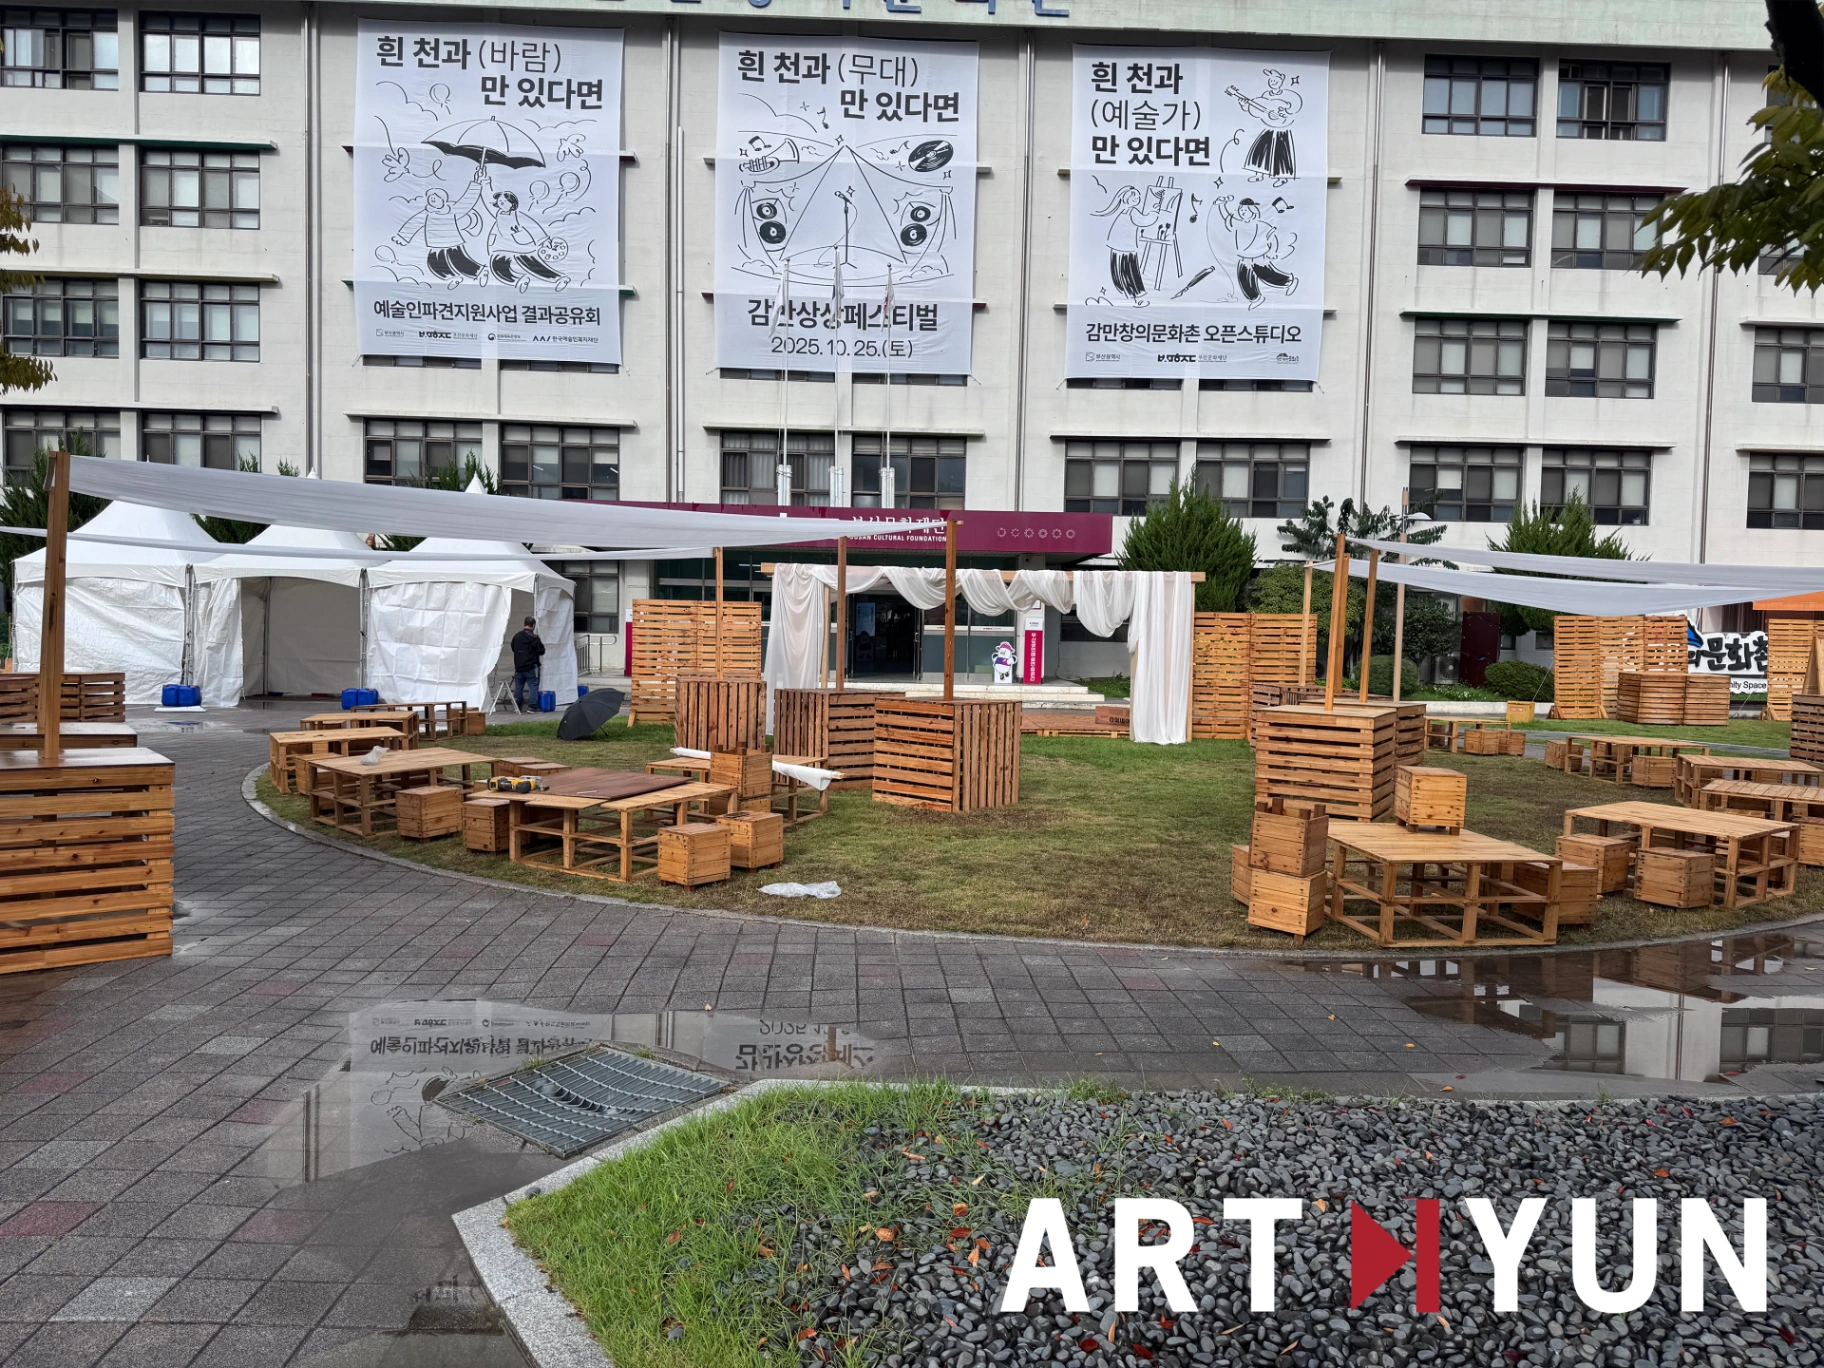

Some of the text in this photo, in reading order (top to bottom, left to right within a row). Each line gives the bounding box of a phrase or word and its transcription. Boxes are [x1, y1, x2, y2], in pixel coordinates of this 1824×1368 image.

[376, 35, 562, 74] 흰 천과 (바람)
[737, 50, 919, 88] 흰 천과 (무대)
[481, 75, 603, 110] 만 있다면
[1091, 62, 1183, 95] 흰 천과
[840, 89, 959, 123] 만 있다면
[1090, 99, 1201, 131] (예술가)
[1092, 136, 1210, 167] 만 있다면
[373, 300, 601, 326] 예술인파견지원사업 결과공유회
[1086, 322, 1302, 345] 감만창의문화촌 오픈스튜디오
[1743, 681, 1767, 691] Space
